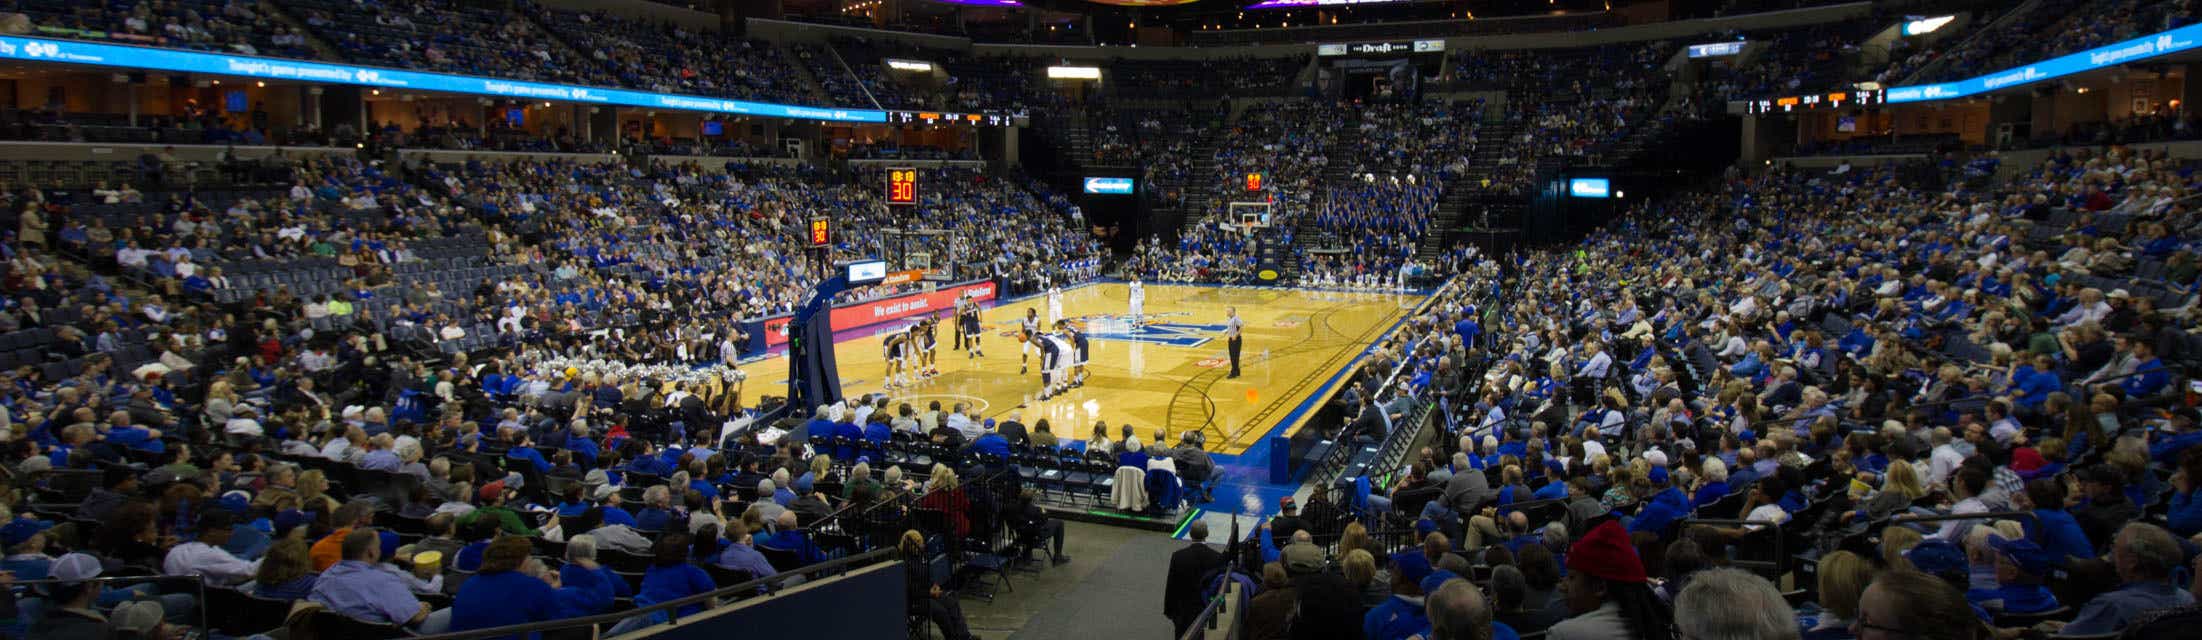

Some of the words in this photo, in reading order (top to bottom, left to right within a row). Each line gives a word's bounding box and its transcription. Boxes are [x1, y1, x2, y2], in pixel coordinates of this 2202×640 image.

[1363, 42, 1392, 53] Draft
[893, 183, 912, 200] 30
[815, 231, 826, 243] 30
[874, 305, 885, 318] We
[886, 302, 901, 315] exist
[902, 301, 909, 313] to
